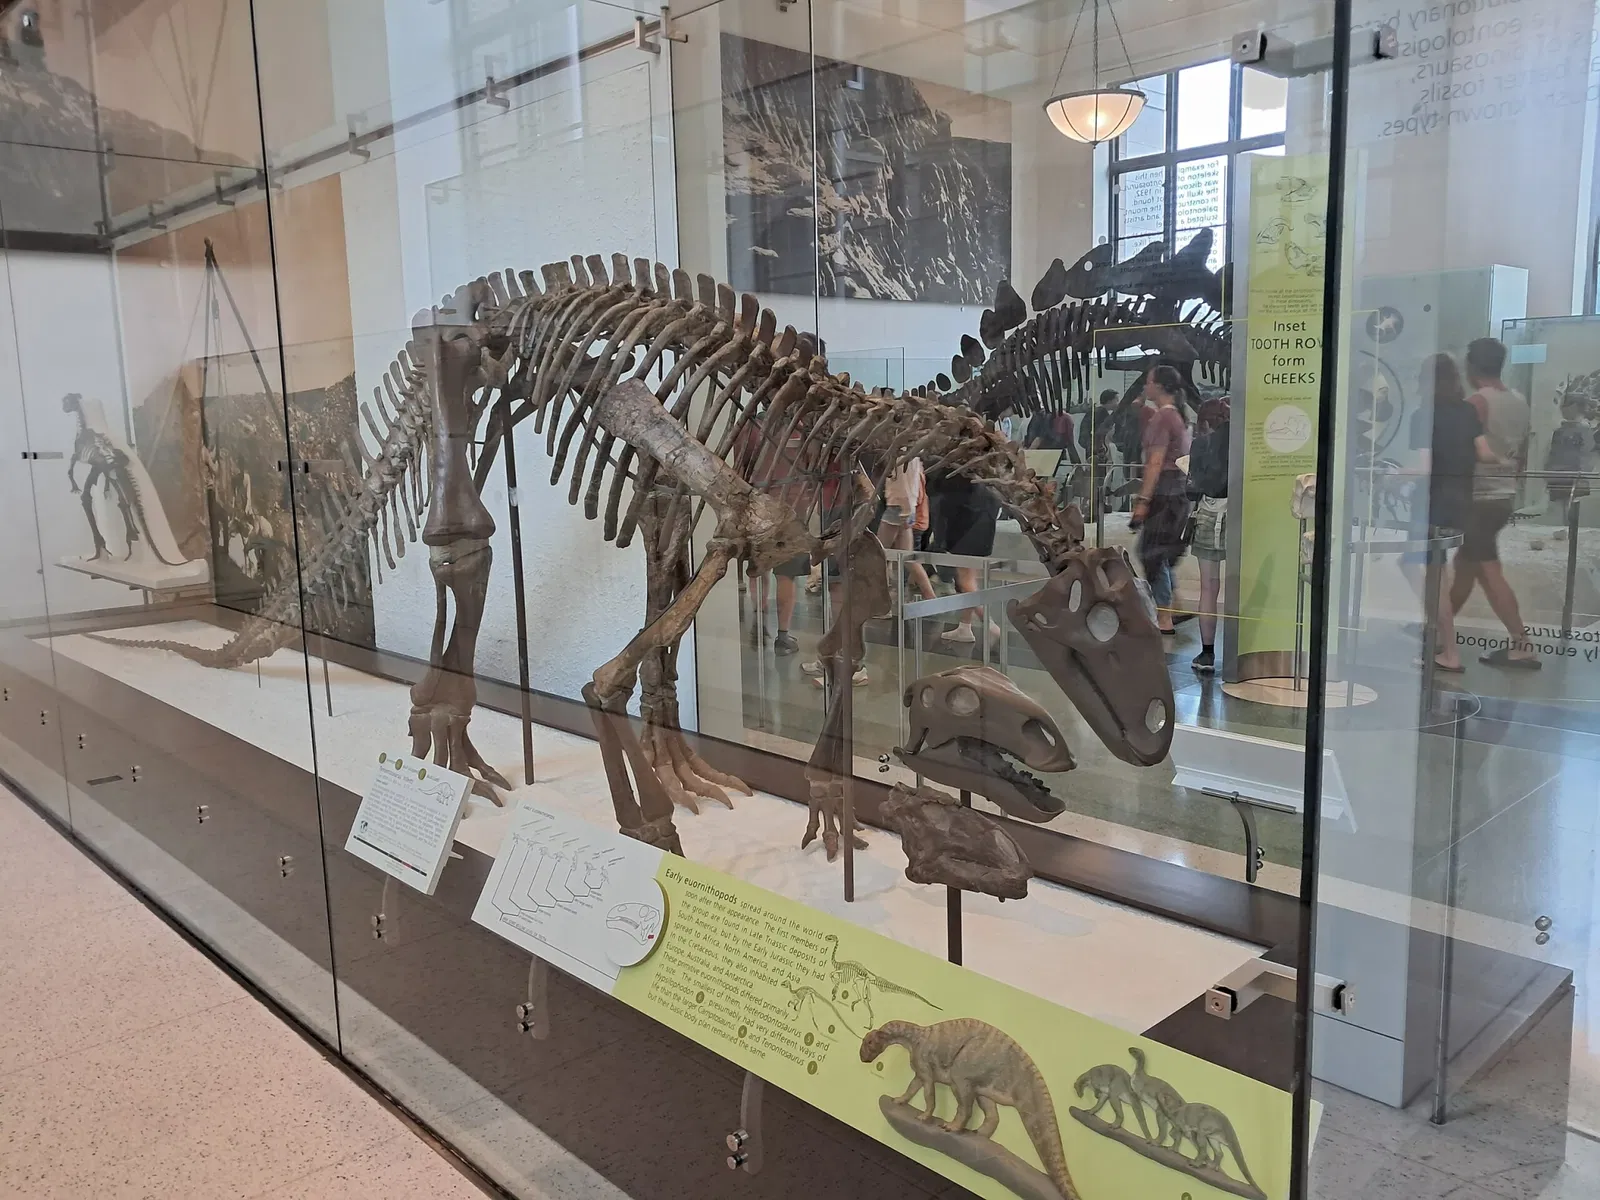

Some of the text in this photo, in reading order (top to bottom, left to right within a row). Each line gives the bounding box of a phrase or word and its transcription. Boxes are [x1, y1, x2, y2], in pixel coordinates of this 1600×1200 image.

[1273, 320, 1306, 332] Inset
[1251, 338, 1290, 350] TOOTH
[1272, 355, 1305, 366] form
[1263, 372, 1316, 384] CHEEKS
[666, 868, 824, 940] Early euornithopods spread around the world
[682, 900, 690, 909] the
[692, 906, 710, 918] group
[722, 916, 740, 930] found
[750, 929, 762, 940] Late
[765, 935, 788, 952] Triassic
[789, 946, 816, 964] deposits
[819, 960, 828, 968] of
[699, 896, 712, 906] after
[764, 922, 775, 933] The
[777, 927, 788, 938] first
[790, 934, 818, 952] members
[820, 946, 828, 955] of
[678, 910, 694, 921] South
[720, 930, 732, 940] but
[733, 935, 740, 944] by
[742, 939, 752, 948] the
[754, 944, 768, 958] Early
[770, 952, 794, 968] Jurassic
[796, 962, 810, 976] they
[812, 970, 826, 981] had
[694, 930, 700, 938] to
[724, 943, 740, 956] North
[772, 966, 785, 976] and
[712, 965, 724, 974] and
[722, 956, 734, 968] they
[736, 963, 748, 972] also
[750, 970, 778, 986] inhabited
[763, 1001, 790, 1020] primarily
[742, 1016, 755, 1027] had
[756, 1024, 769, 1036] very
[770, 1030, 798, 1048] different
[800, 1045, 816, 1058] ways
[817, 1054, 826, 1062] of
[816, 1040, 830, 1052] and
